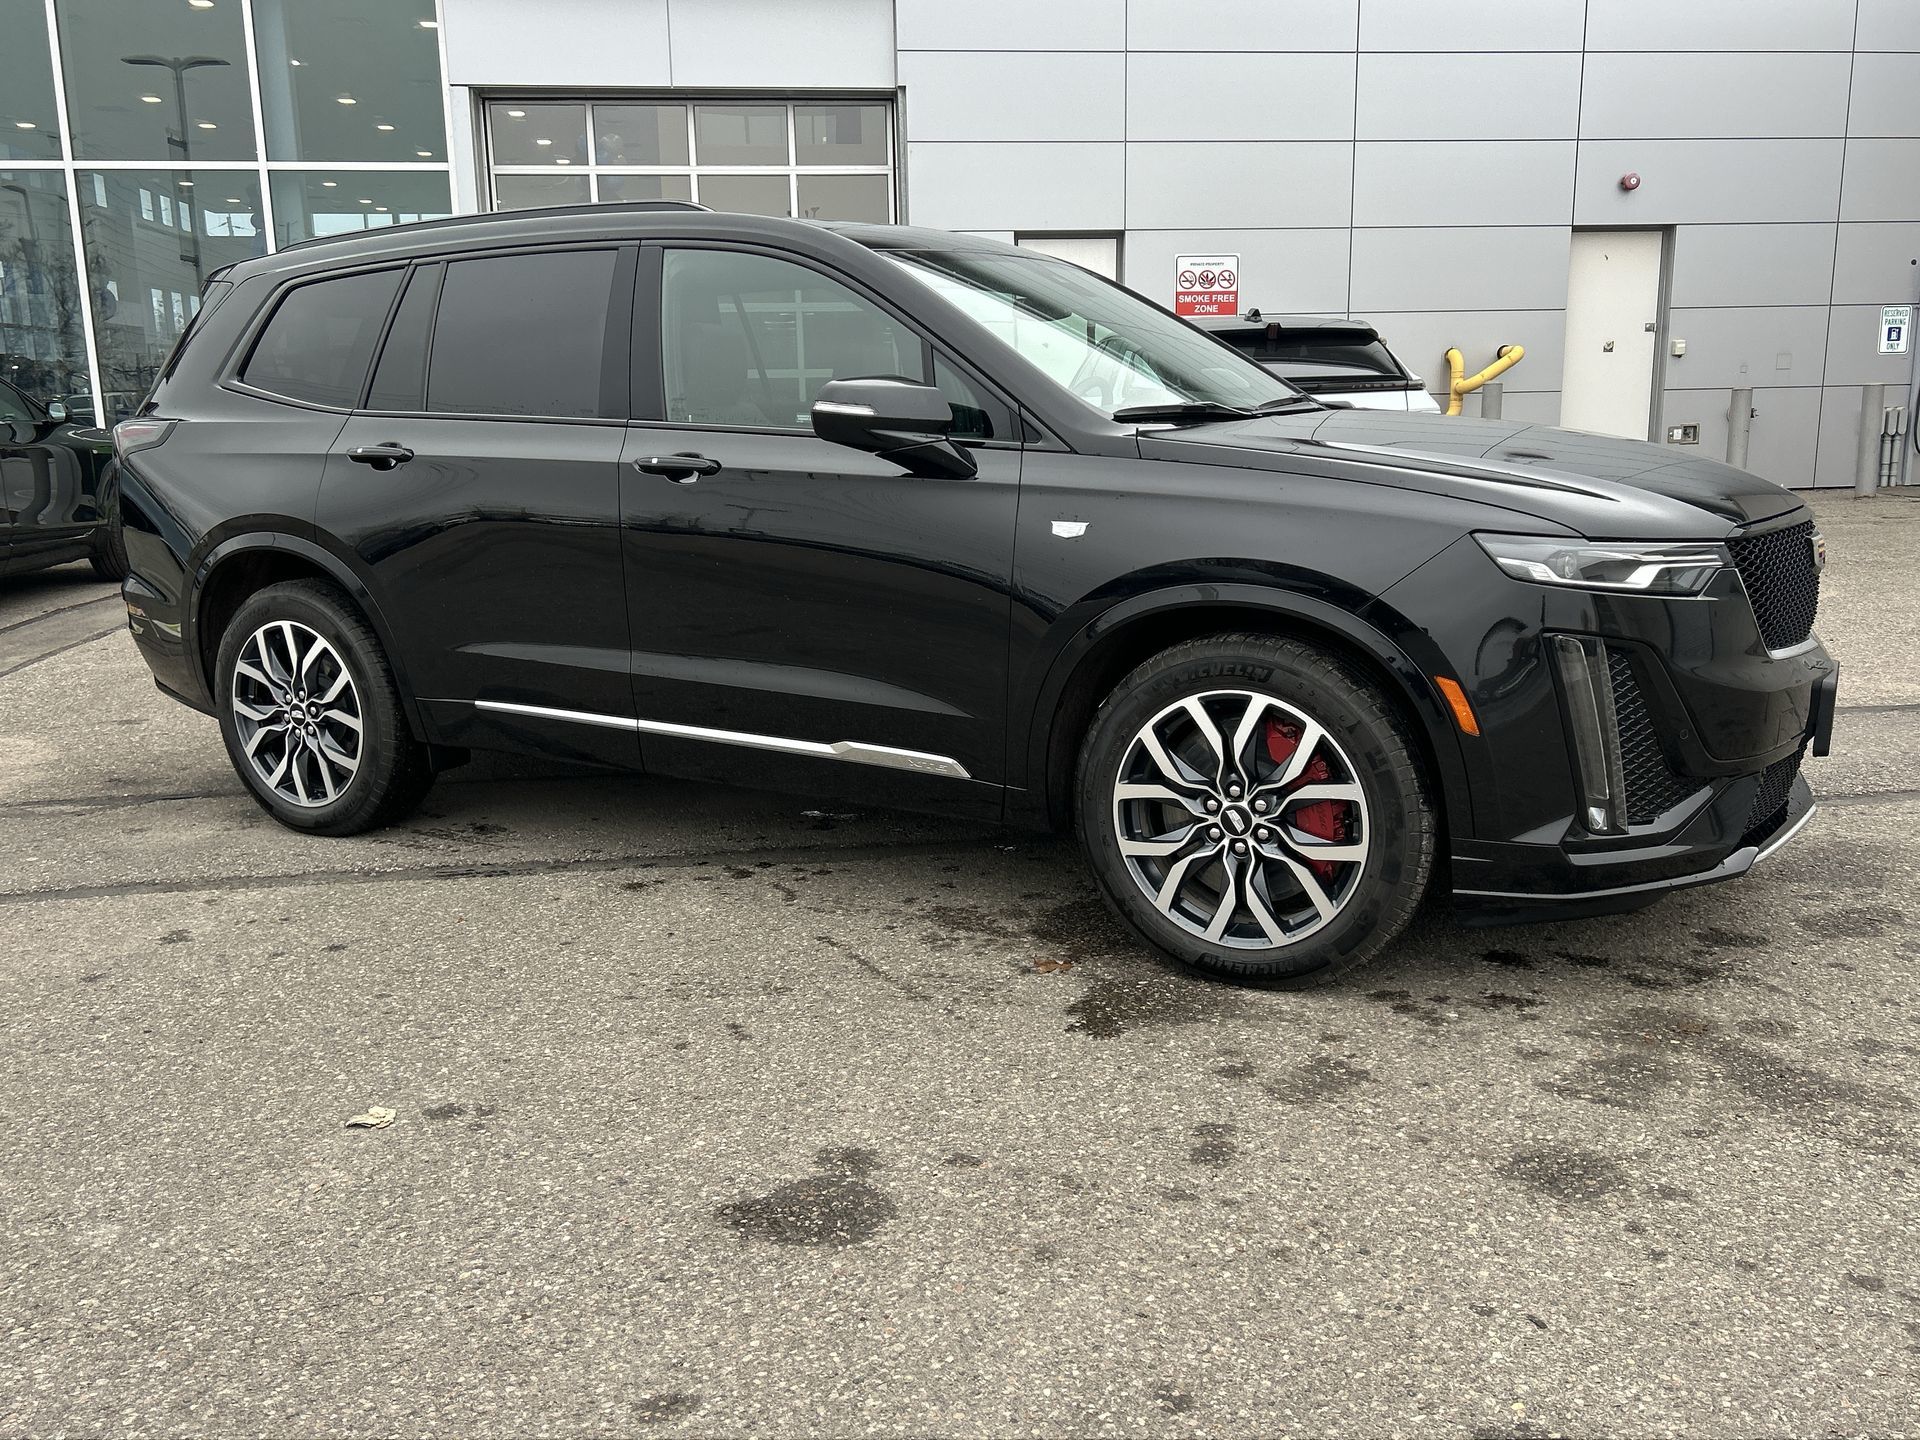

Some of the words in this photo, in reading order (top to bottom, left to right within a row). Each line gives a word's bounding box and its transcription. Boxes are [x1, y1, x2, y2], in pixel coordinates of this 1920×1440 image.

[1178, 294, 1210, 303] SMOKE
[1212, 294, 1235, 302] FREE
[1194, 304, 1219, 313] ZONE
[1884, 309, 1909, 317] RESERVED
[1884, 318, 1907, 326] PARKING
[1886, 342, 1900, 350] ONLY
